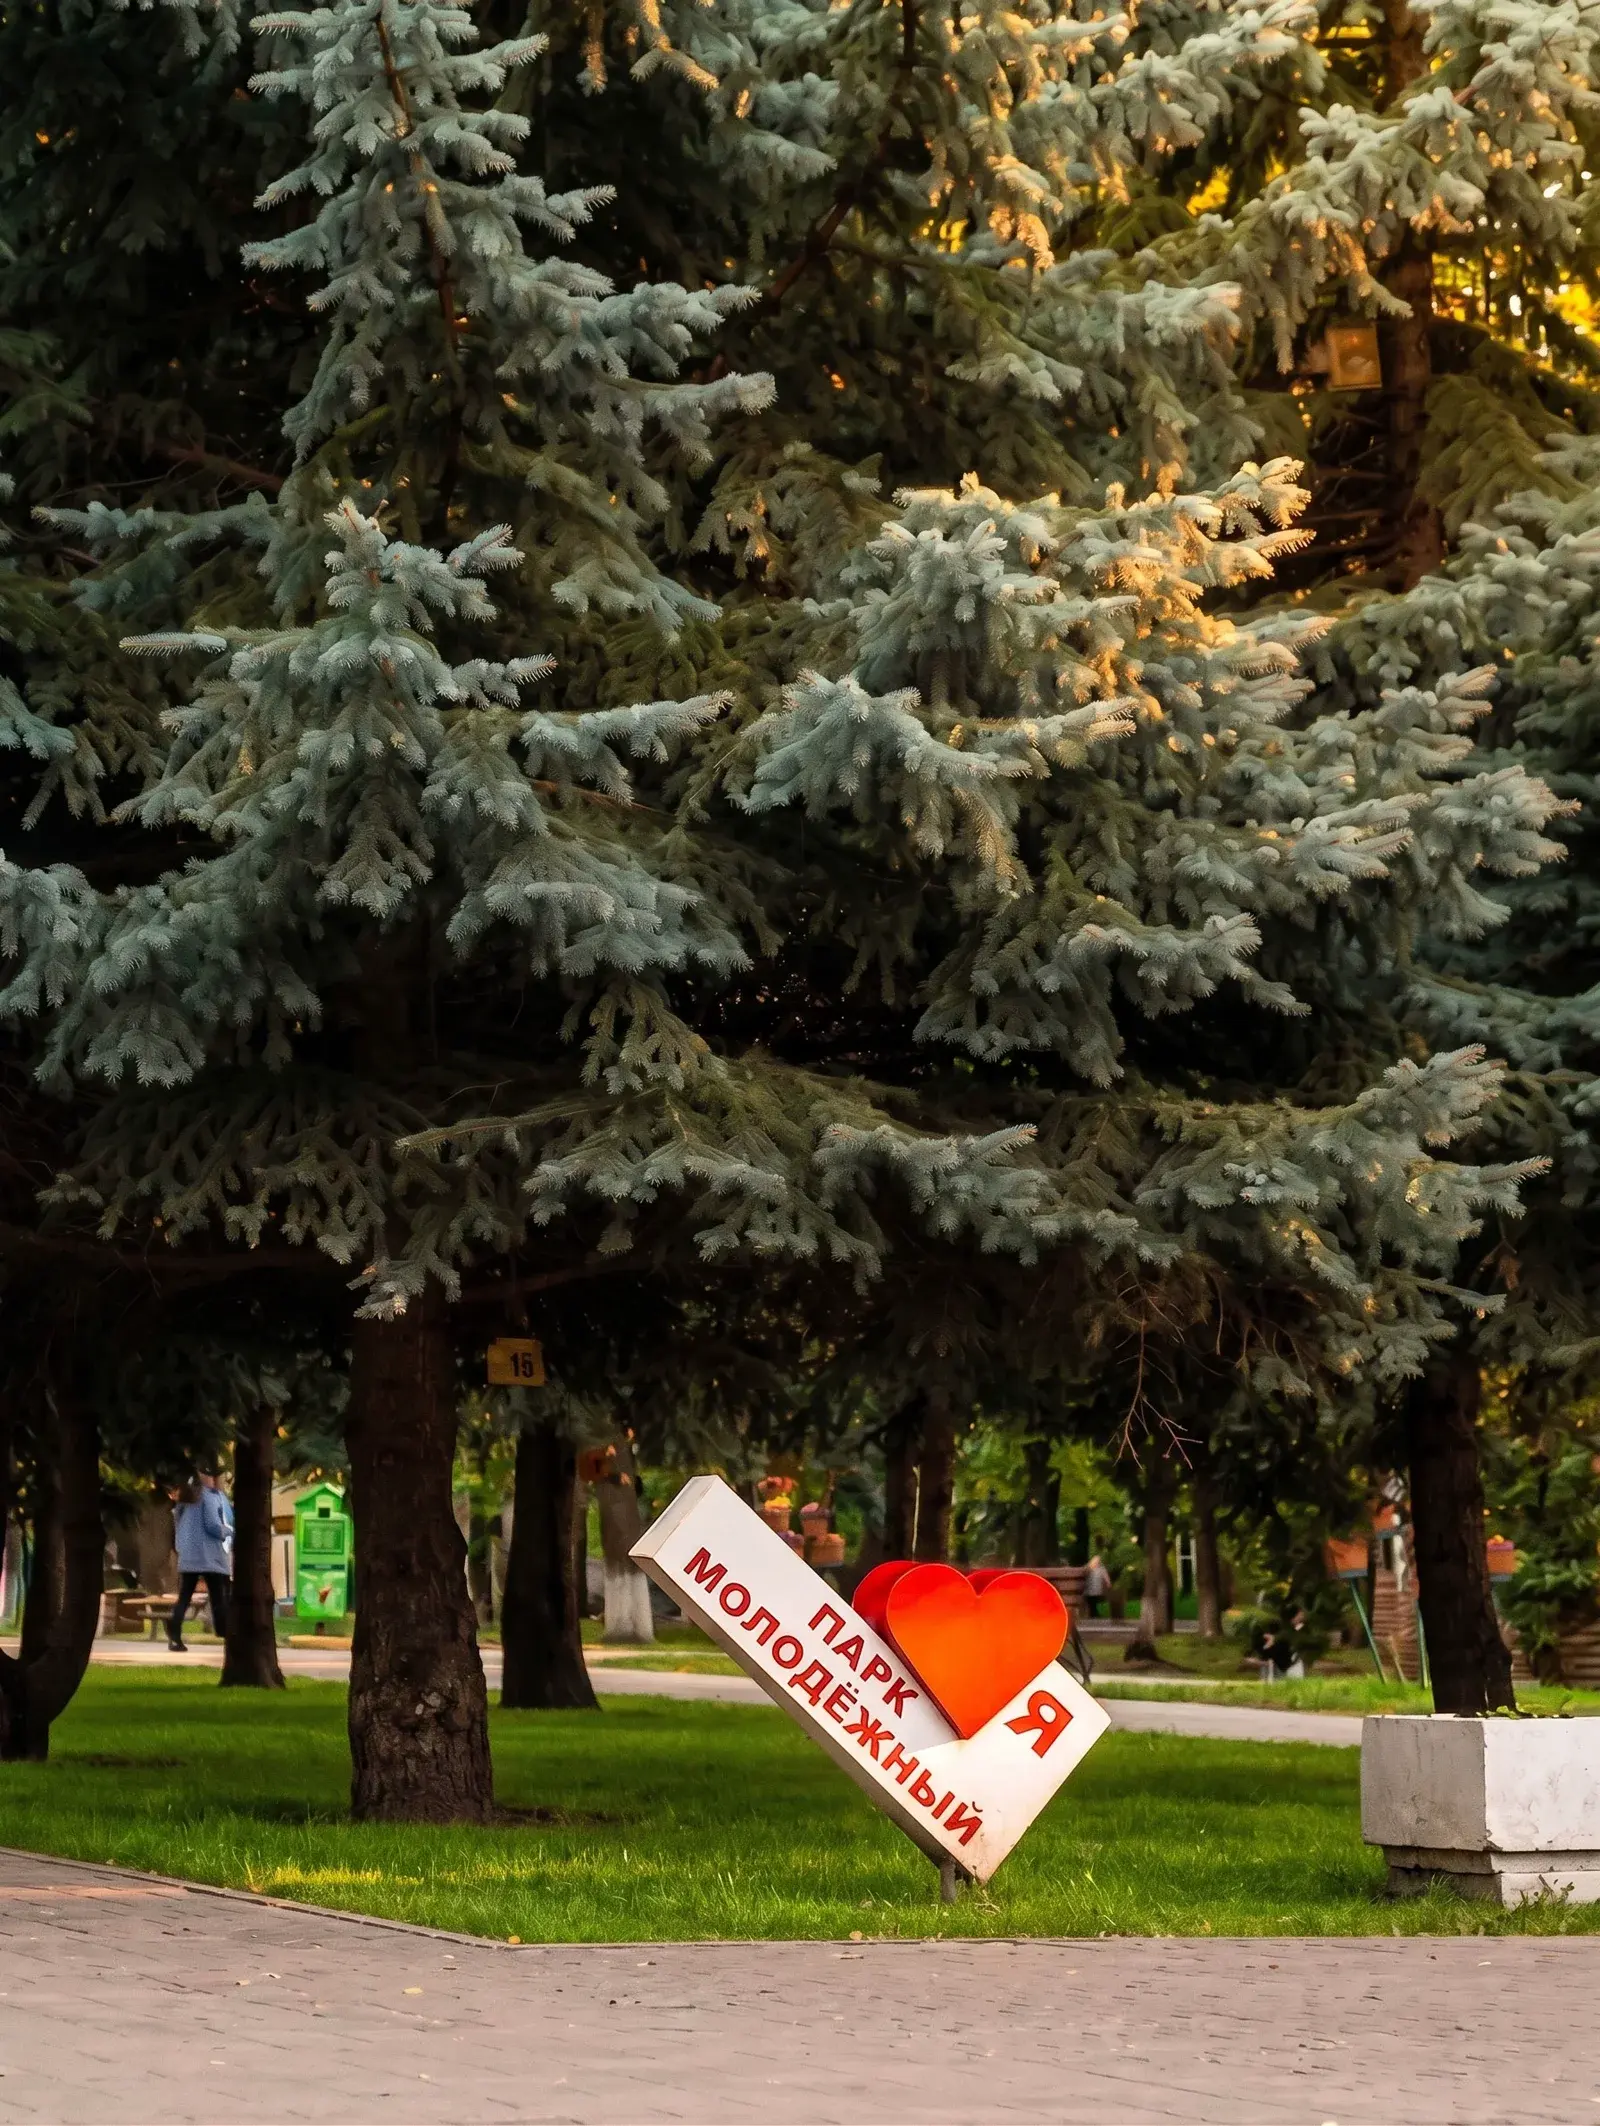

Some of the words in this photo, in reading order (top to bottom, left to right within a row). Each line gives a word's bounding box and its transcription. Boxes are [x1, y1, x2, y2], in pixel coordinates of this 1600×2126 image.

[510, 1351, 534, 1378] 15
[683, 1547, 984, 1847] МОЛОДЁЖНЫЙ
[807, 1603, 920, 1719] ПАРК
[1004, 1690, 1074, 1759] Я
